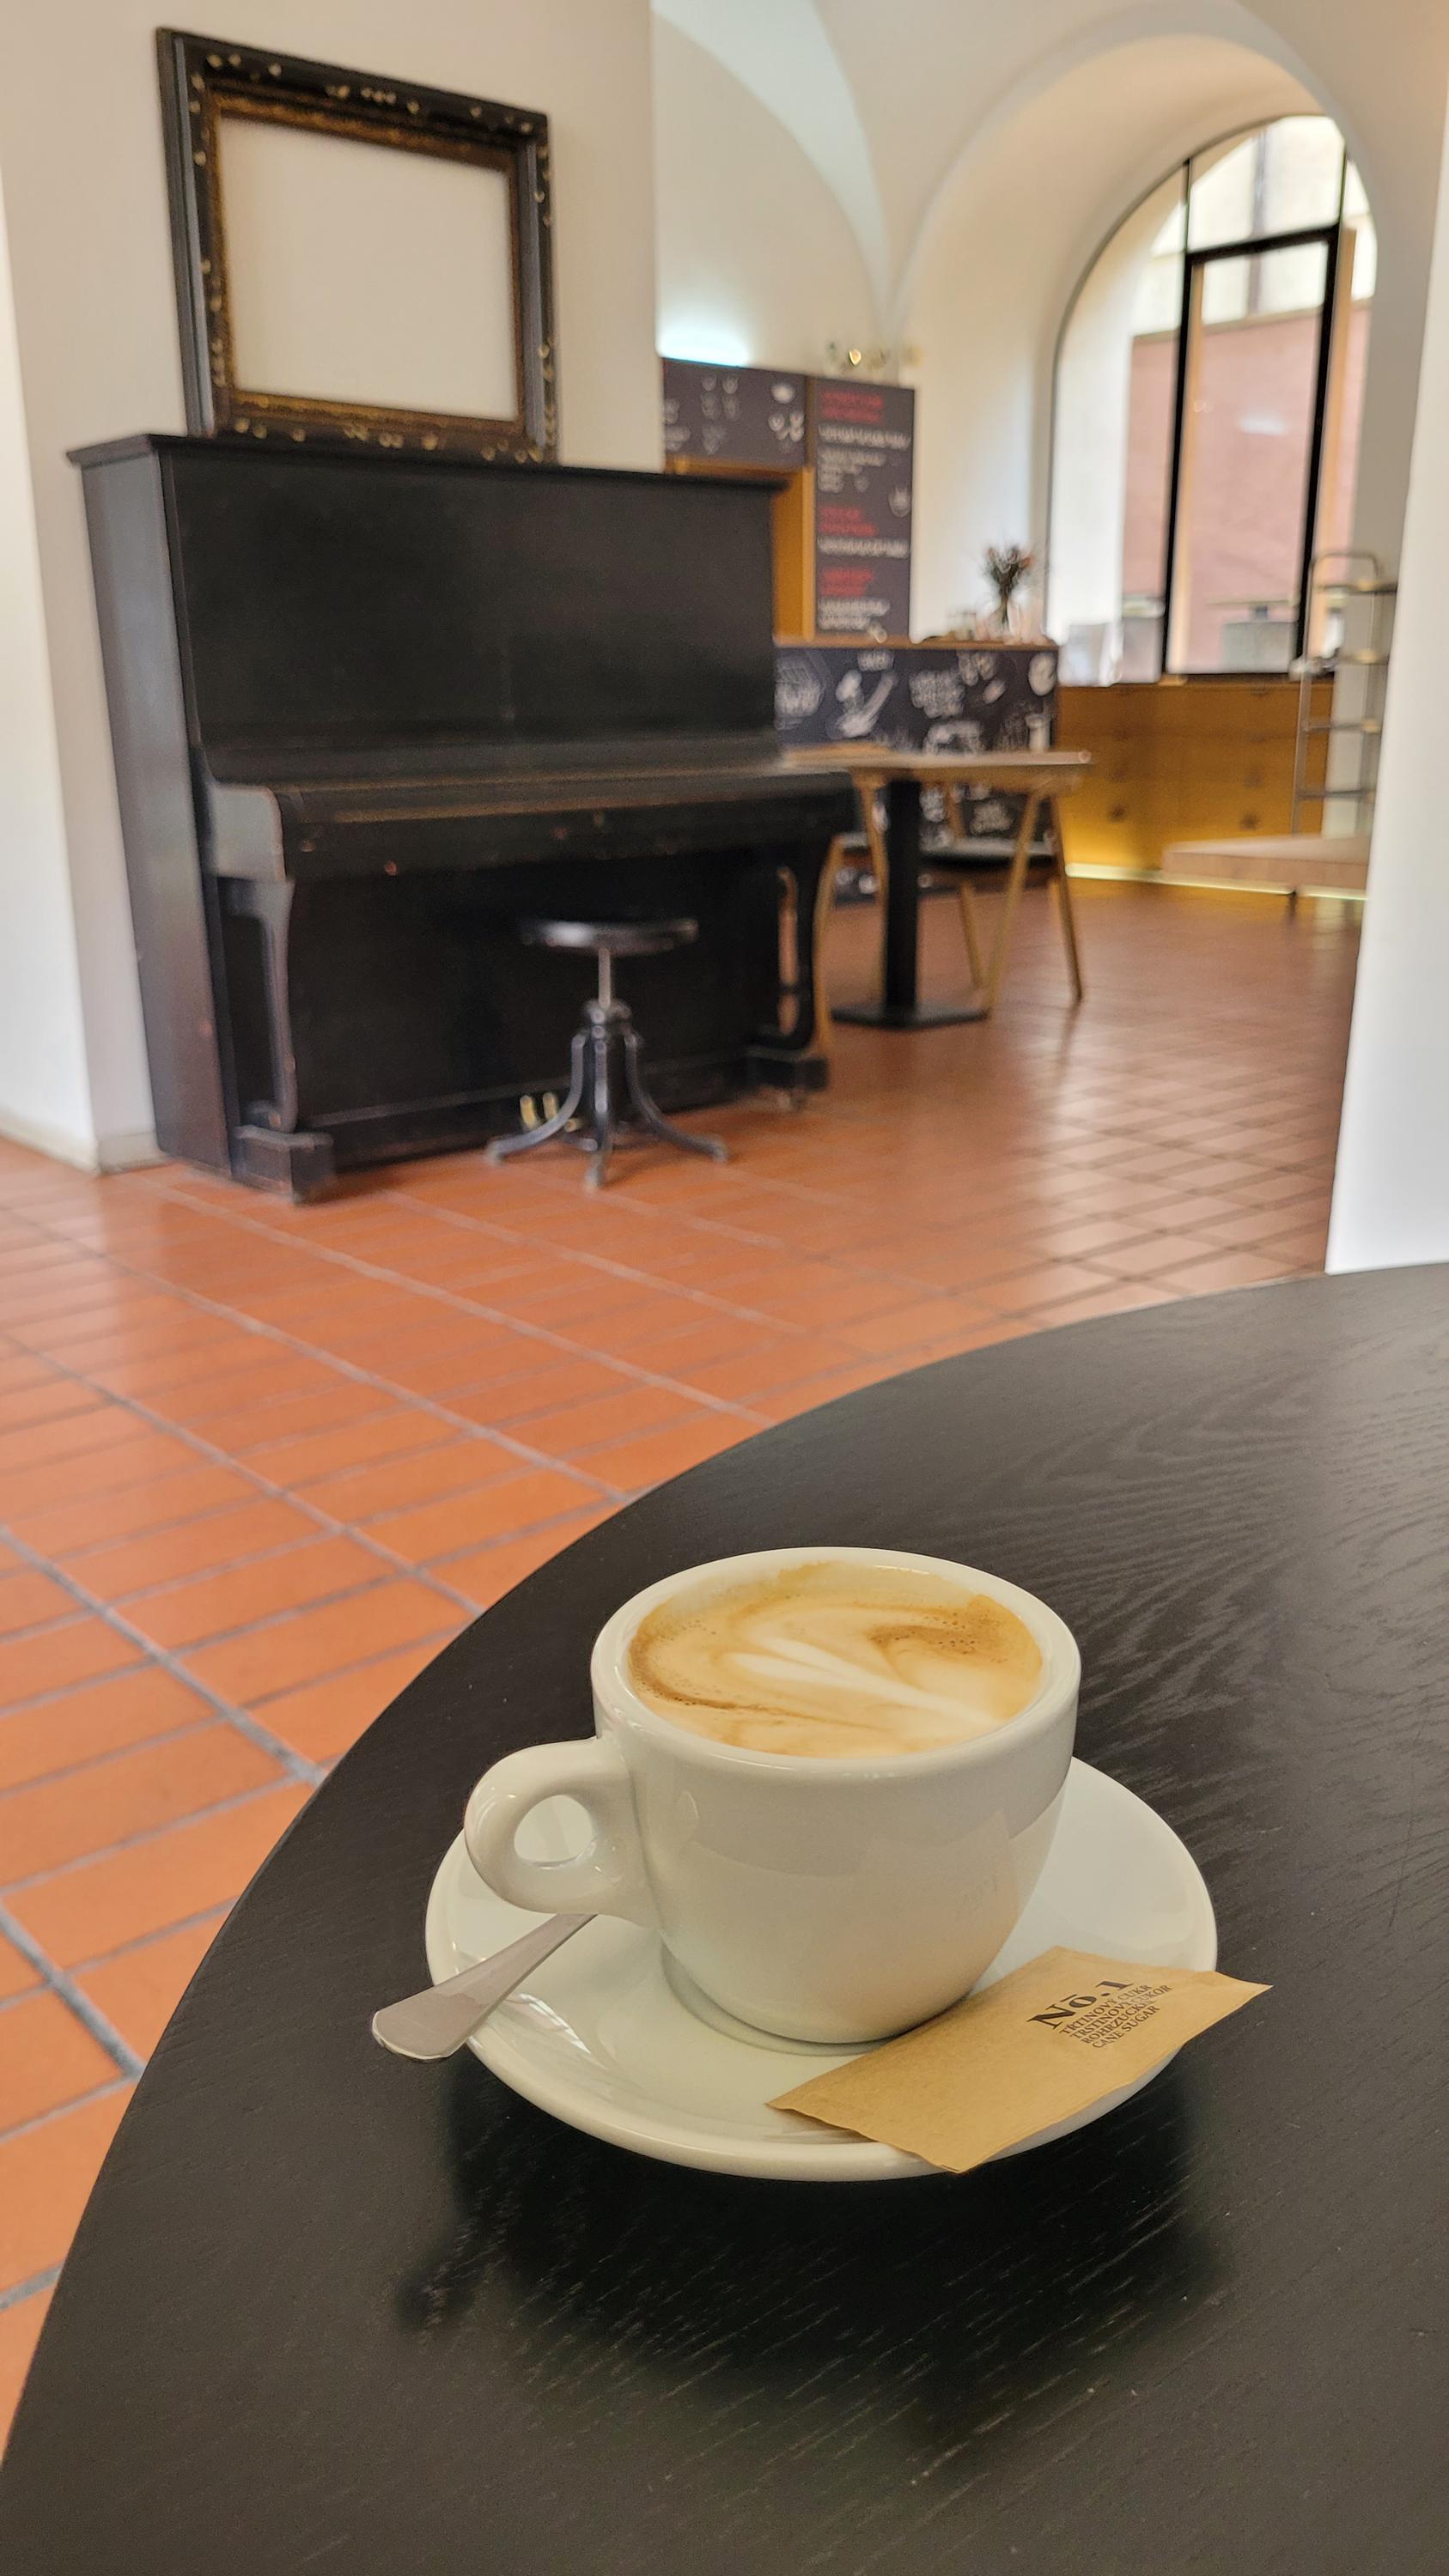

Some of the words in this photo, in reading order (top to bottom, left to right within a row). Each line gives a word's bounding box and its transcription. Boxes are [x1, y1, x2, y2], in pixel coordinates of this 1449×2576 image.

[1117, 1984, 1153, 2001] CUKR
[1130, 1984, 1173, 2002] CUKOR
[1093, 2032, 1125, 2049] CANE
[1121, 2005, 1160, 2032] SUGAR
